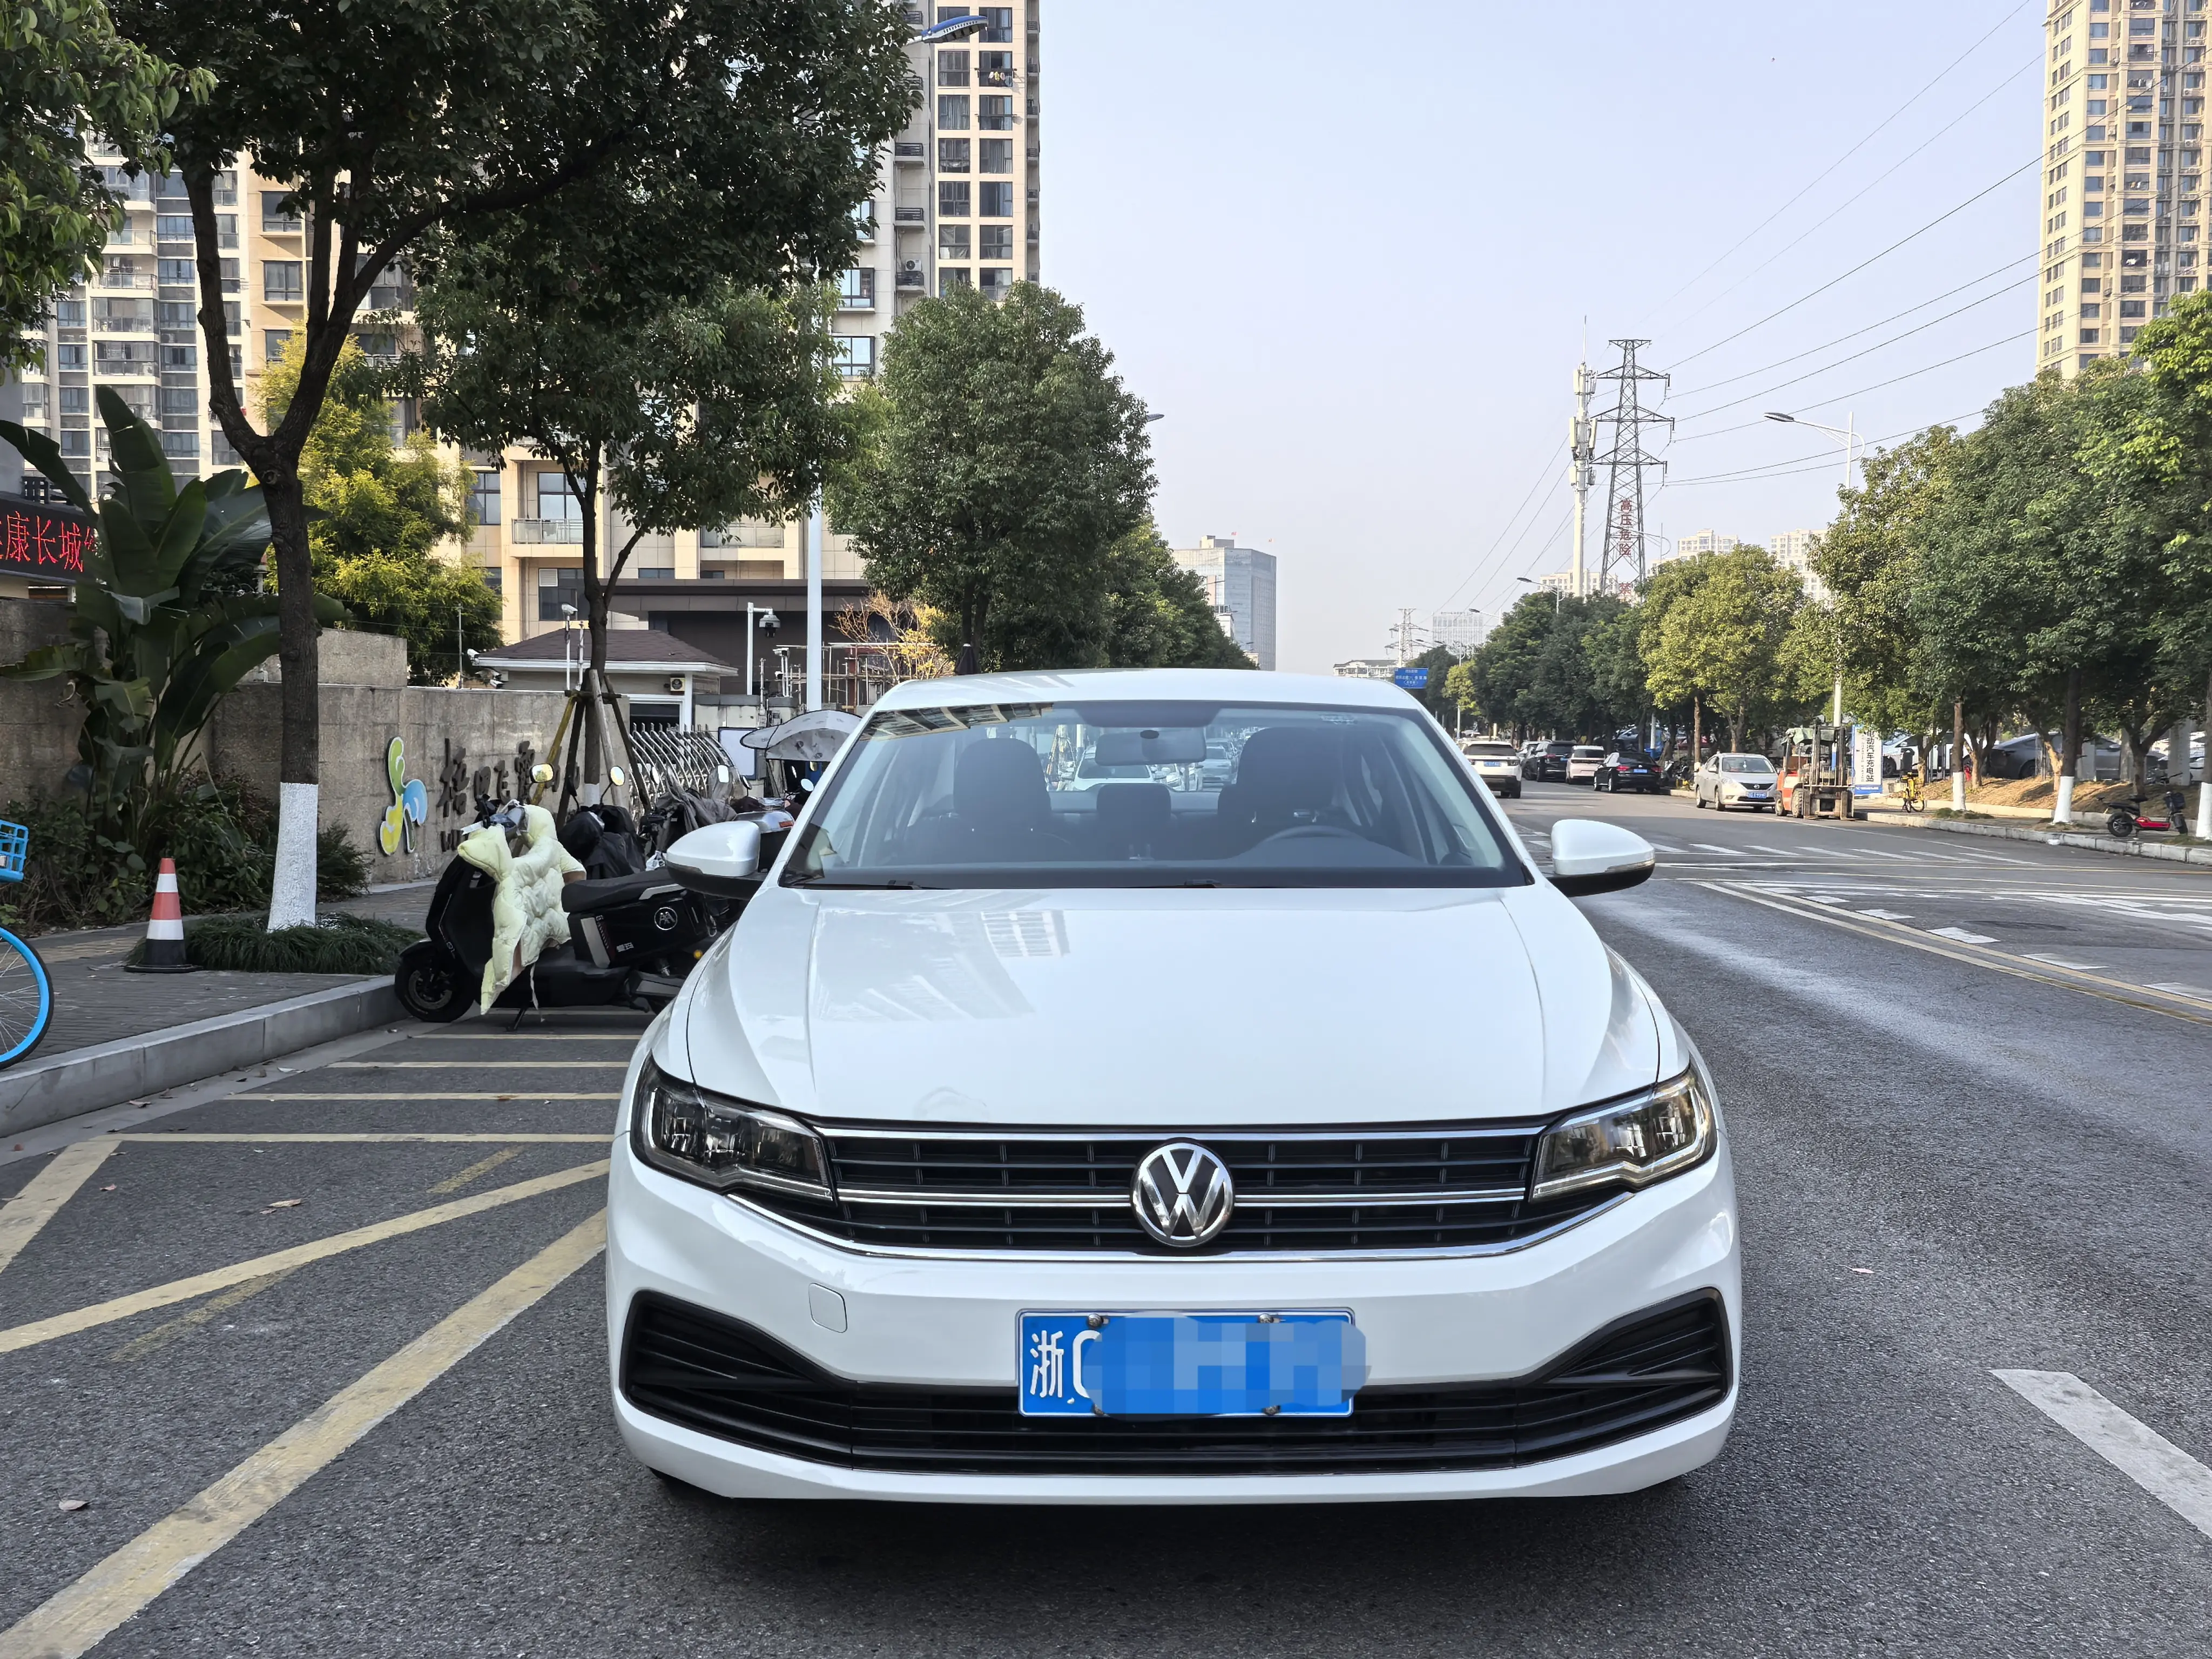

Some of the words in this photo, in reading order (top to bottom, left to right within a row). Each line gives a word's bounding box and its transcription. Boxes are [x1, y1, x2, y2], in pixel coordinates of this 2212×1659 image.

[0, 510, 96, 572] 康长城
[1620, 500, 1632, 556] 高压危险
